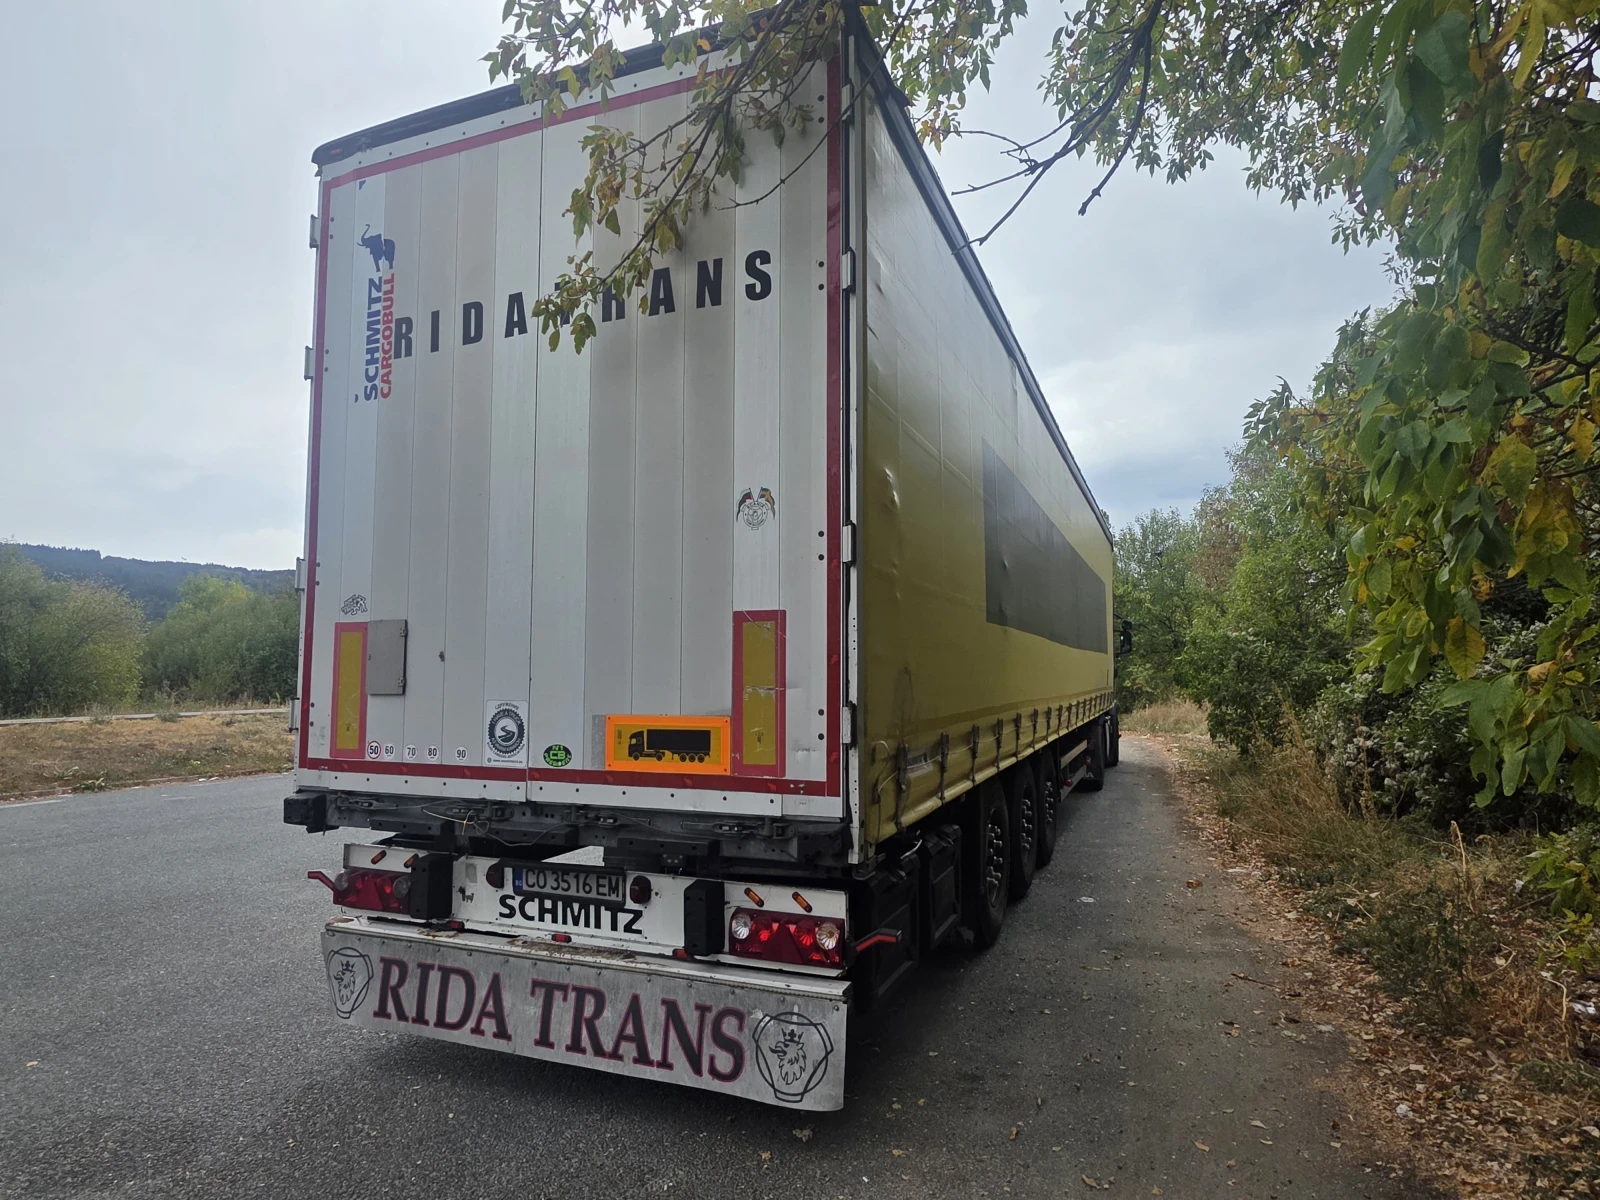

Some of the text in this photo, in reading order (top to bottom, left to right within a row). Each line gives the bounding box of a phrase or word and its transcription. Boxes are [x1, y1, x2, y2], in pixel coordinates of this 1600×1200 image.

[363, 275, 383, 402] SCHMITZ
[380, 272, 395, 399] CARGOBULL
[393, 291, 528, 360] RIDA
[369, 745, 467, 758] 50 60 70 80 90
[550, 750, 566, 760] CB
[515, 879, 523, 887] BG
[550, 871, 593, 895] 3516
[596, 875, 620, 898] EM
[498, 894, 644, 935] SCHMITZ
[372, 955, 747, 1083] RIDA TRANS
